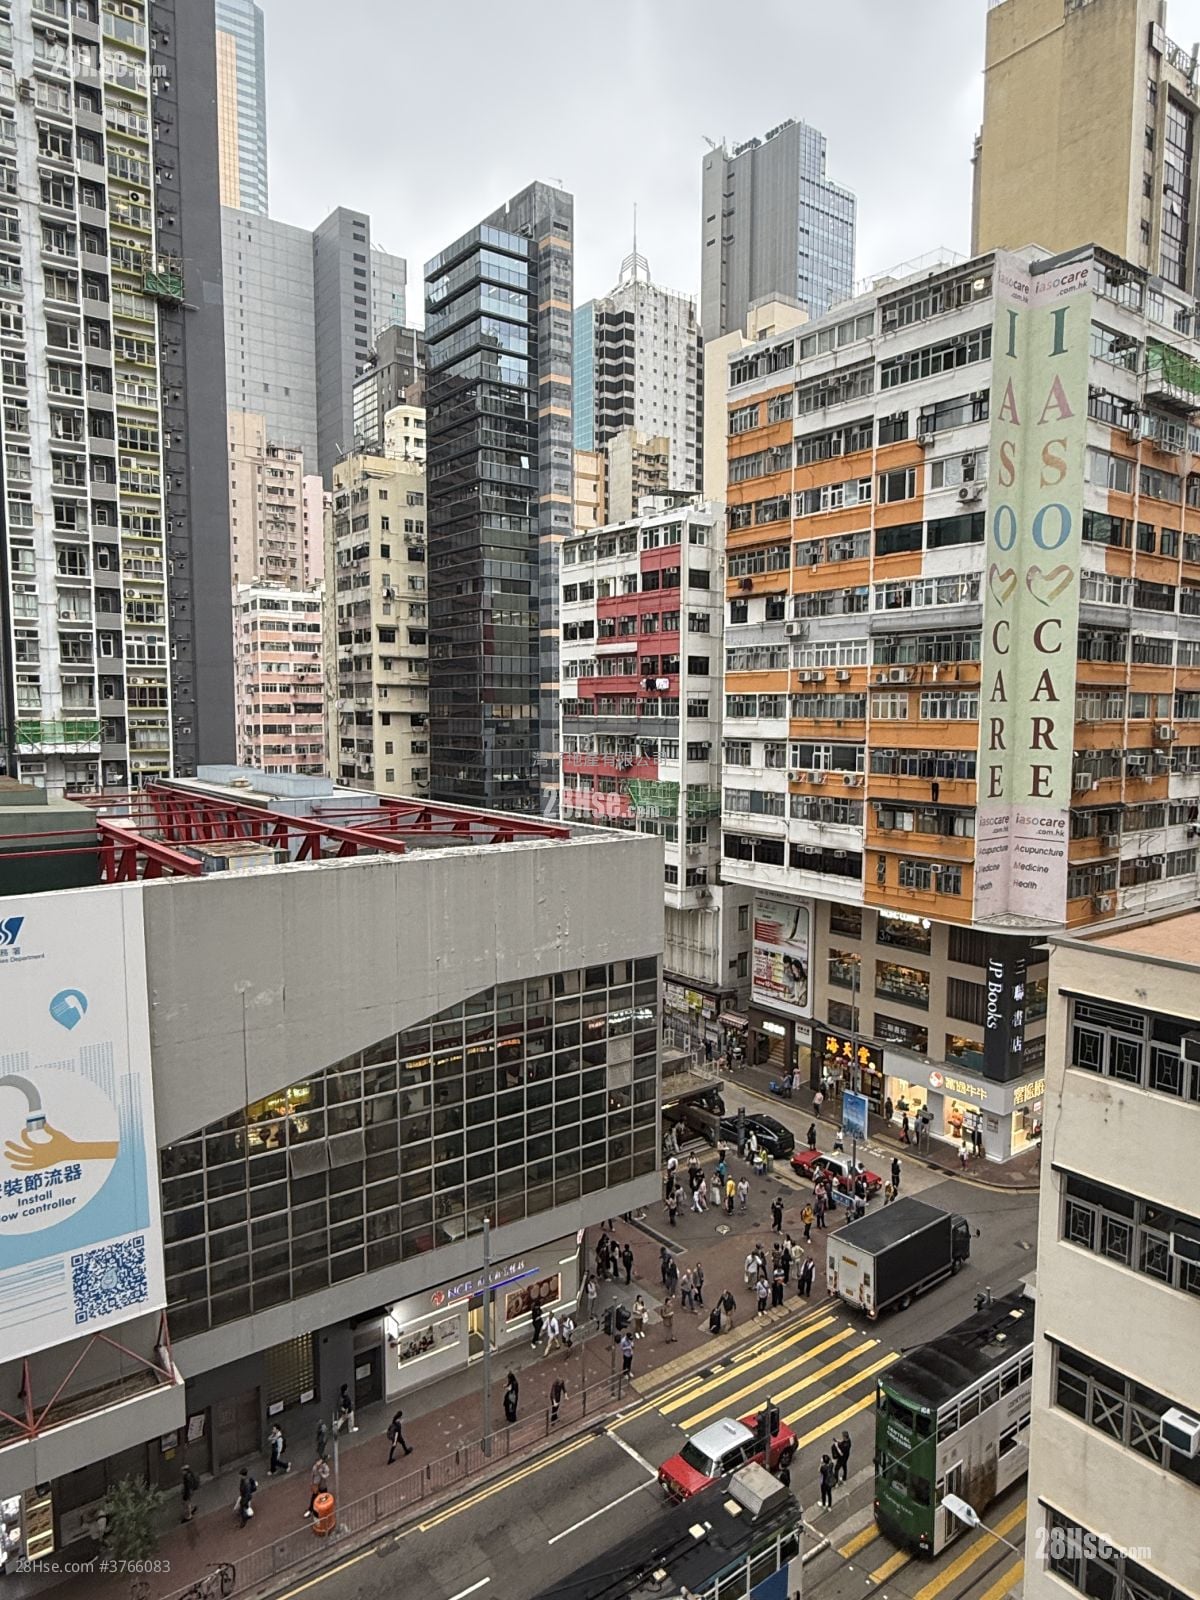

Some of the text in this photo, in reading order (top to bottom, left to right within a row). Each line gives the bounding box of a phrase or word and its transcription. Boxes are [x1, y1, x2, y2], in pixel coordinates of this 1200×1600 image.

[1035, 267, 1089, 294] iasocare
[1056, 279, 1088, 297] .com.hk
[979, 815, 1010, 827] iasocare
[1015, 813, 1066, 829] iasocare
[1036, 828, 1065, 837] .com.hk
[1014, 843, 1064, 857] Acupuncture
[1013, 861, 1049, 874] Medicine
[1013, 879, 1038, 890] Health
[10, 952, 45, 963] Department
[987, 957, 1003, 1030] JP Books
[17, 1190, 53, 1207] Install
[22, 1196, 77, 1217] controller
